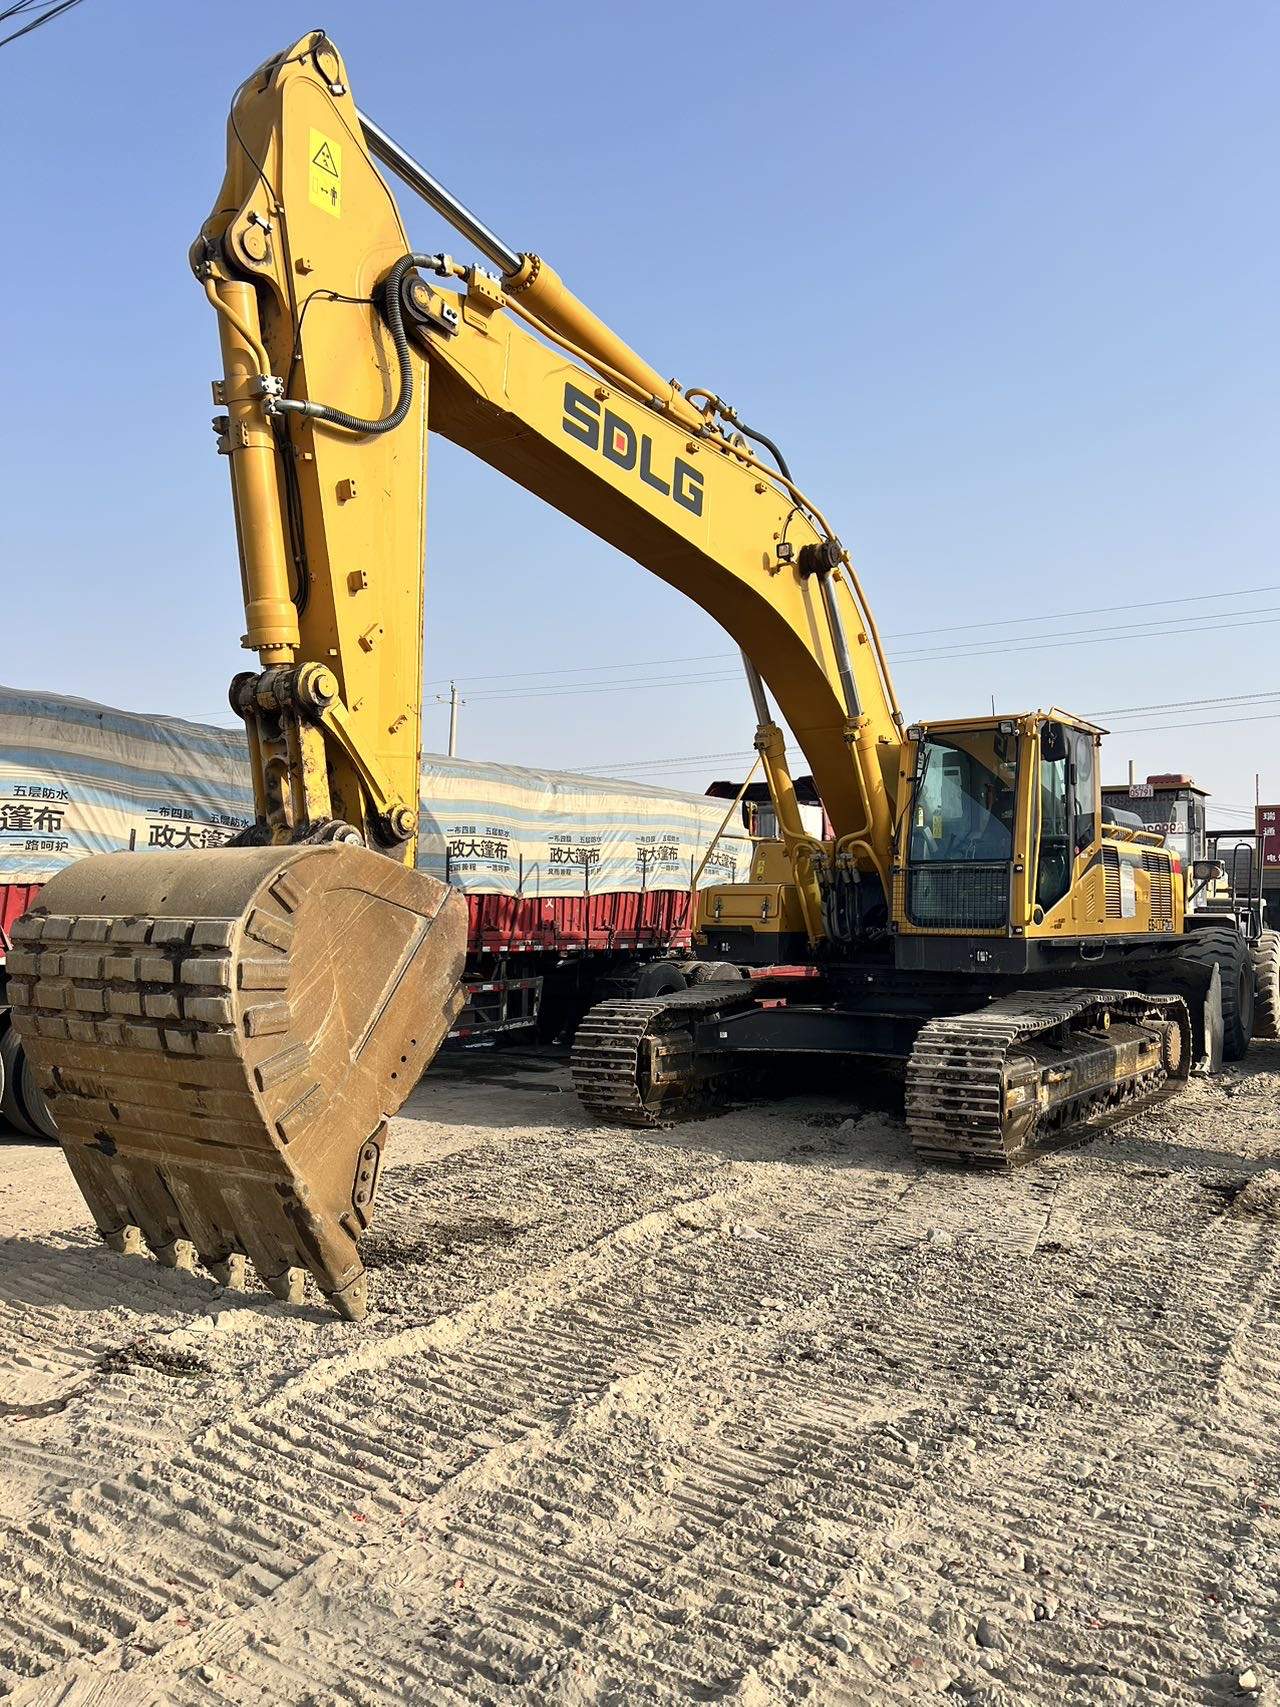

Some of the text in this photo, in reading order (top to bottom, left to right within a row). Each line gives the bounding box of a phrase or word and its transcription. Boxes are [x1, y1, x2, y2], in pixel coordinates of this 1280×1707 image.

[563, 382, 704, 517] SDLG
[13, 785, 69, 800] 五层防水
[0, 804, 65, 833] 篷布
[210, 813, 250, 828] 五层防水
[9, 839, 69, 851] 一路呵护
[148, 824, 235, 849] 政大篷
[448, 839, 508, 860] 政大篷布
[550, 847, 600, 865] 政大篷布
